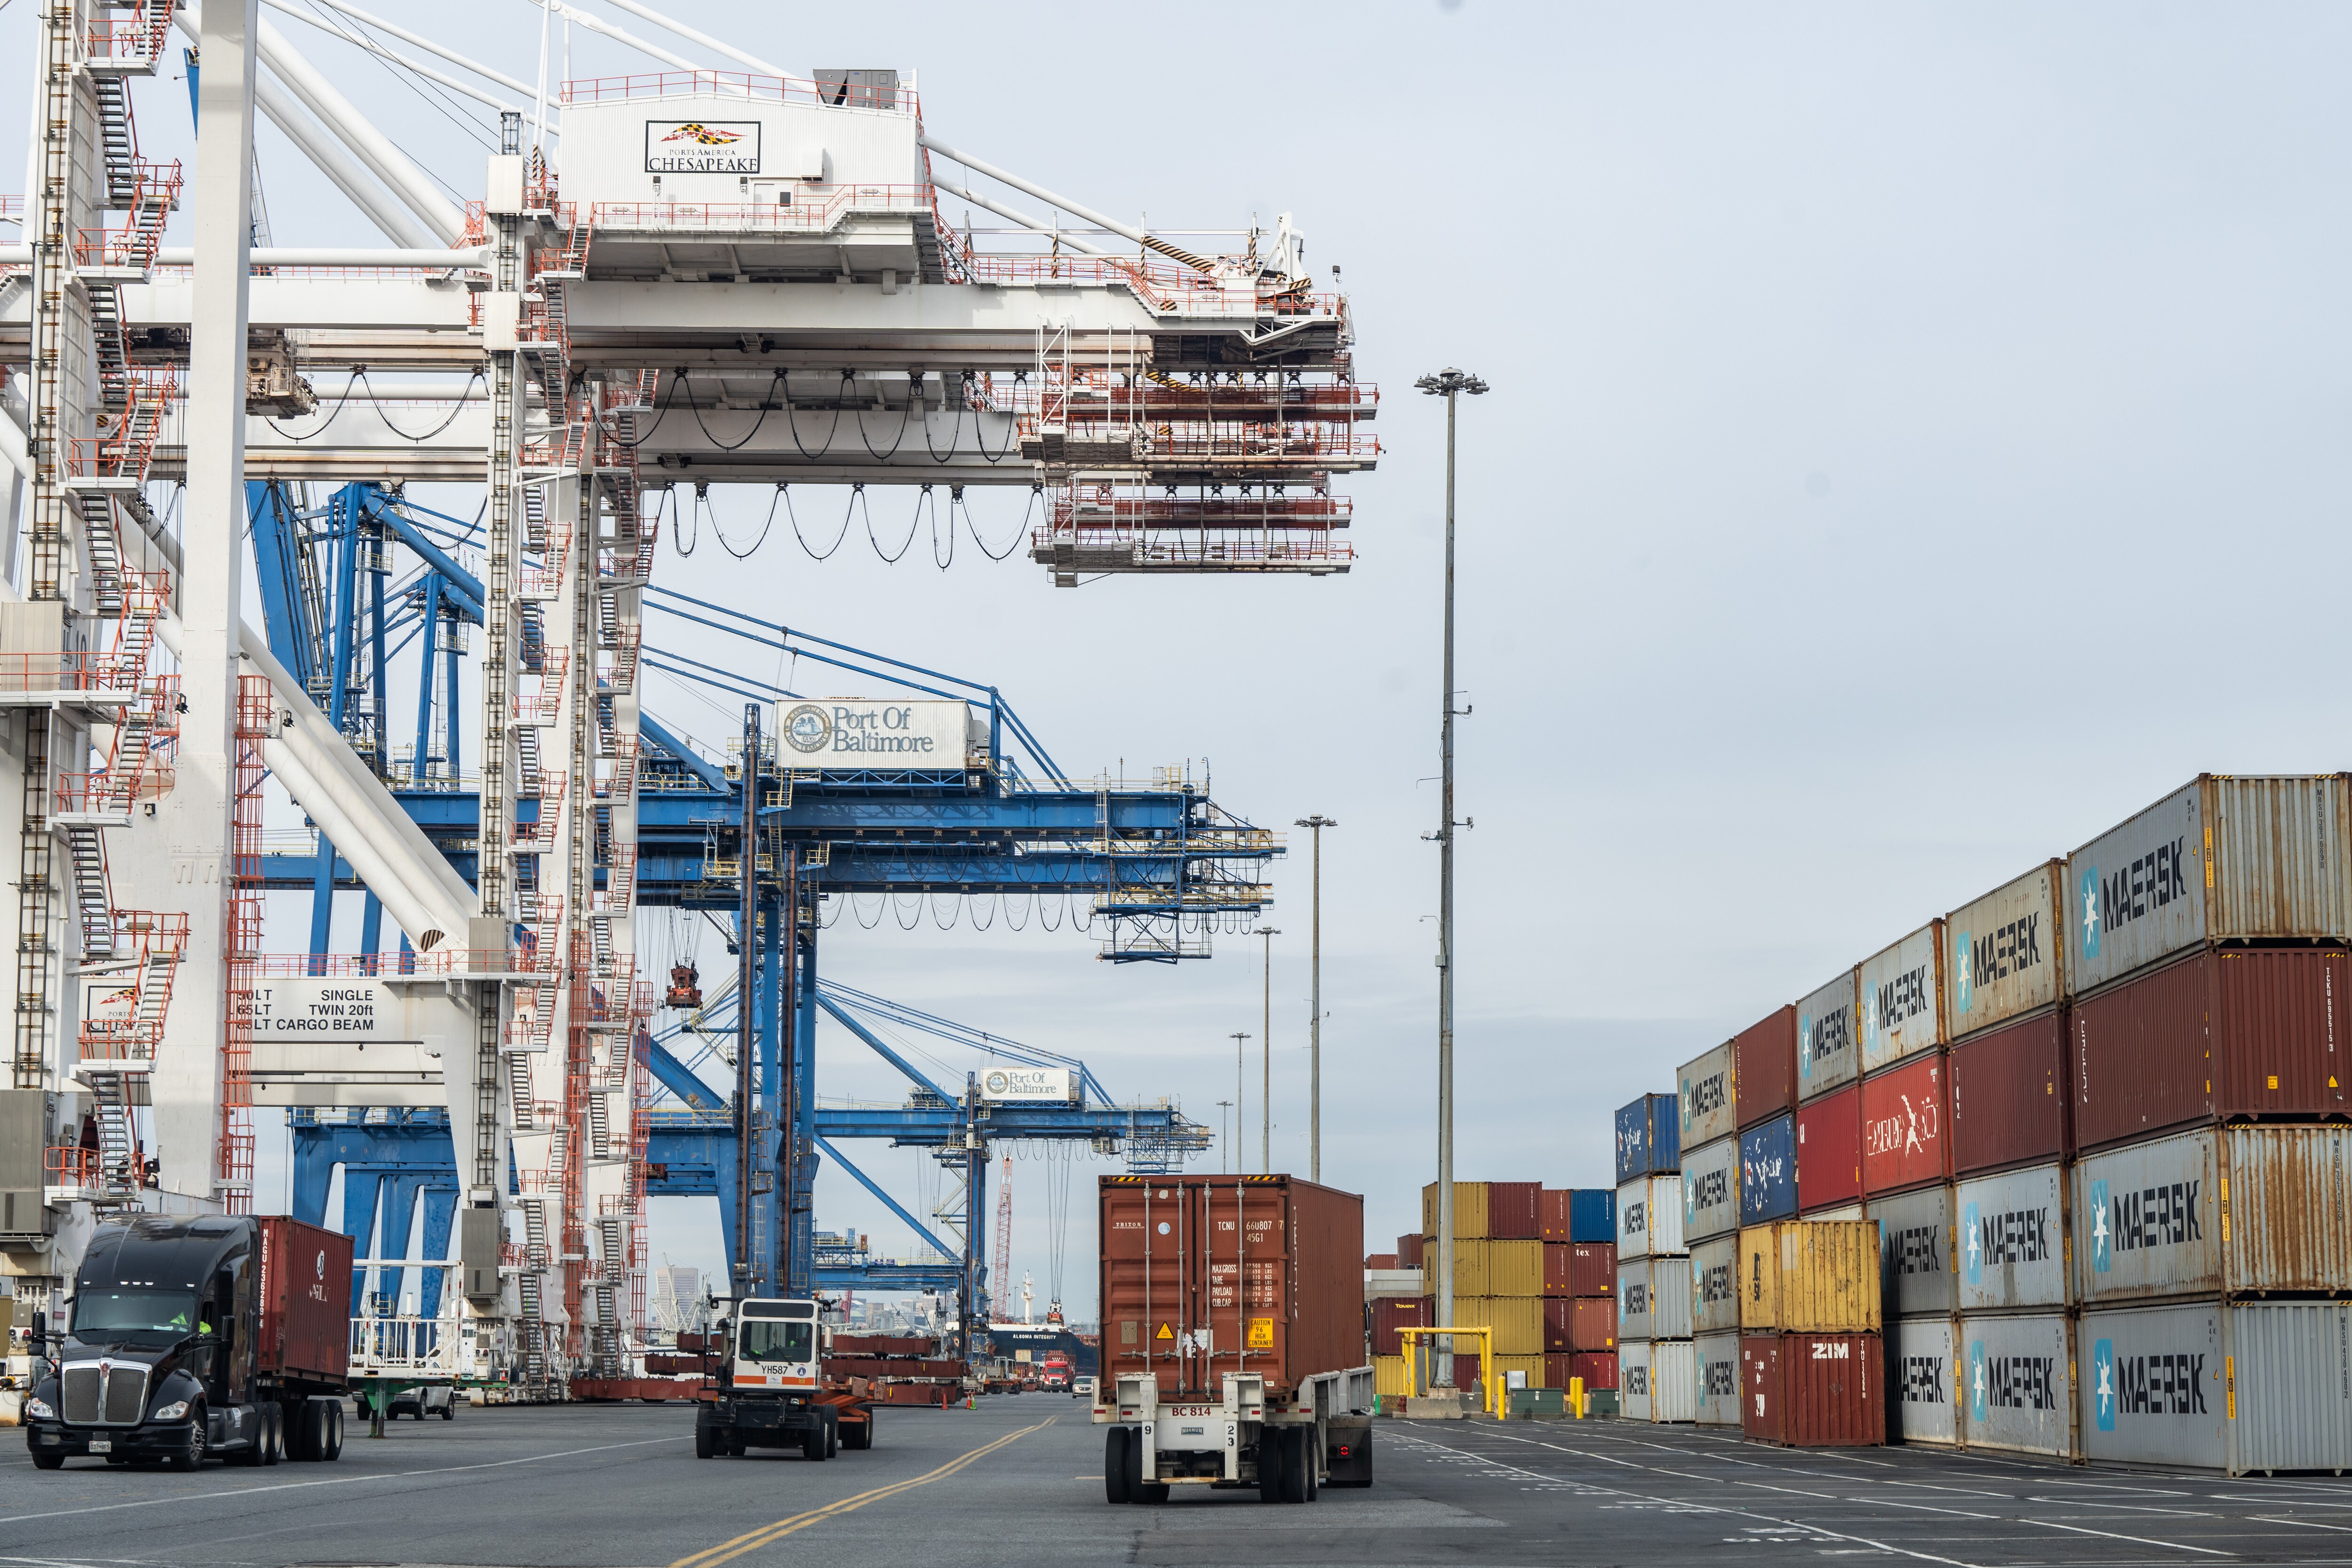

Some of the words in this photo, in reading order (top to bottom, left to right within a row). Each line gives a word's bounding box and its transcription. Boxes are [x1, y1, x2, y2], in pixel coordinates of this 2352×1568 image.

[649, 158, 757, 171] CHESAPEAKE
[832, 707, 878, 729] Port
[883, 706, 911, 730] Of
[832, 729, 934, 752] Baltimore
[2103, 836, 2186, 933] MAERSK
[1974, 911, 2041, 988] MAERSK
[321, 990, 373, 1001] SINGLE
[1878, 964, 1927, 1031] MAERSK
[309, 1004, 345, 1015] TWIN
[349, 1004, 373, 1016] 20ft
[276, 1019, 328, 1030] CARGO
[333, 1019, 373, 1030] BEAM
[1812, 1004, 1849, 1062] MAERSK
[1009, 1072, 1030, 1082] Port
[1033, 1072, 1045, 1082] Of
[1009, 1083, 1057, 1093] Baltimore
[1691, 1071, 1726, 1118] MAERSK
[1695, 1168, 1729, 1210] MAERSK
[1218, 1221, 1235, 1231] TCNU
[1246, 1221, 1272, 1230] 660807
[1279, 1220, 1284, 1230] 7
[1624, 1201, 1645, 1236] MAERSK
[2114, 1180, 2202, 1252] MAERSK
[1247, 1233, 1263, 1242] 45G1
[1983, 1207, 2049, 1265] MAERSK
[1888, 1225, 1940, 1276] MAERSK
[1212, 1276, 1223, 1284] TARE
[1212, 1287, 1232, 1296] PAYLOAD
[1212, 1298, 1232, 1307] CUB.CAP.
[1625, 1284, 1647, 1314] MAERSK
[1812, 1343, 1849, 1359] ZIM
[762, 1365, 788, 1375] YH587
[1626, 1366, 1648, 1395] MAERSK
[1706, 1361, 1735, 1396] MAERSK
[1891, 1357, 1945, 1403] MAERSK
[1988, 1357, 2056, 1410] MAERSK
[2118, 1353, 2208, 1415] MAERSK
[1172, 1408, 1187, 1416] BC
[1190, 1407, 1211, 1416] 814
[1144, 1425, 1152, 1434] 9
[1228, 1425, 1234, 1434] 2
[1228, 1437, 1234, 1446] 3
